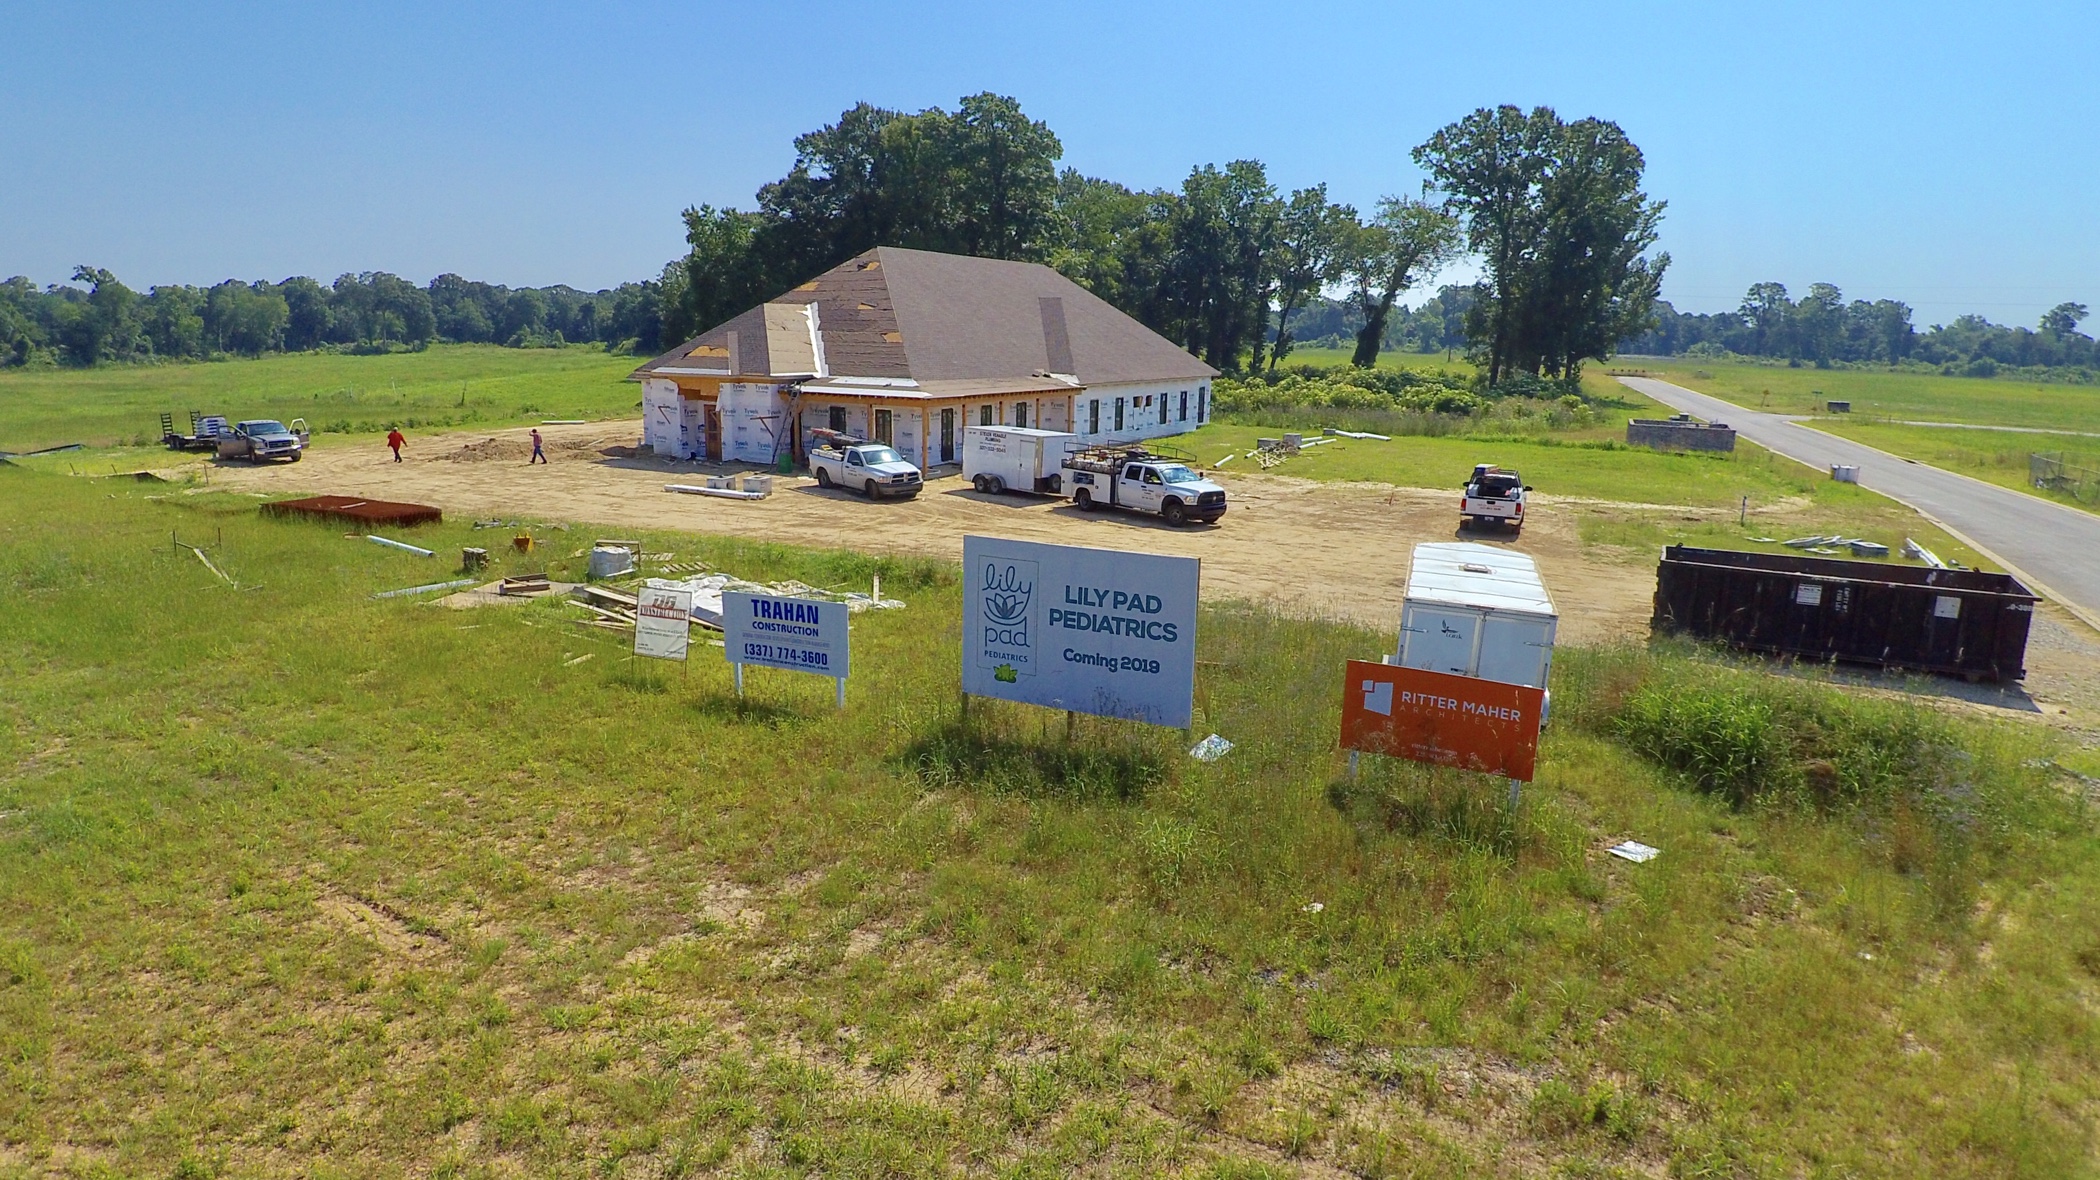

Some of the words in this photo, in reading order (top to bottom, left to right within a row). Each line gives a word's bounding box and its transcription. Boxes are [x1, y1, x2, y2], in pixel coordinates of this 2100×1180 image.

[982, 563, 1032, 597] lily
[751, 599, 819, 624] TRAHAN
[1065, 585, 1109, 608] LILY
[1113, 591, 1162, 614] PAD
[752, 621, 819, 637] CONSTRUCTION
[984, 616, 1030, 647] pad
[1049, 608, 1178, 642] PEDIATRICS
[745, 643, 773, 658] (337)
[777, 646, 828, 666] 774-3600
[984, 650, 1028, 663] PEDIATRICS
[1063, 648, 1118, 673] Coming
[1120, 656, 1160, 674] 2019
[1400, 705, 1520, 732] ARCHITECTS
[1401, 691, 1457, 711] RITTER
[1462, 700, 1521, 722] MAHER
